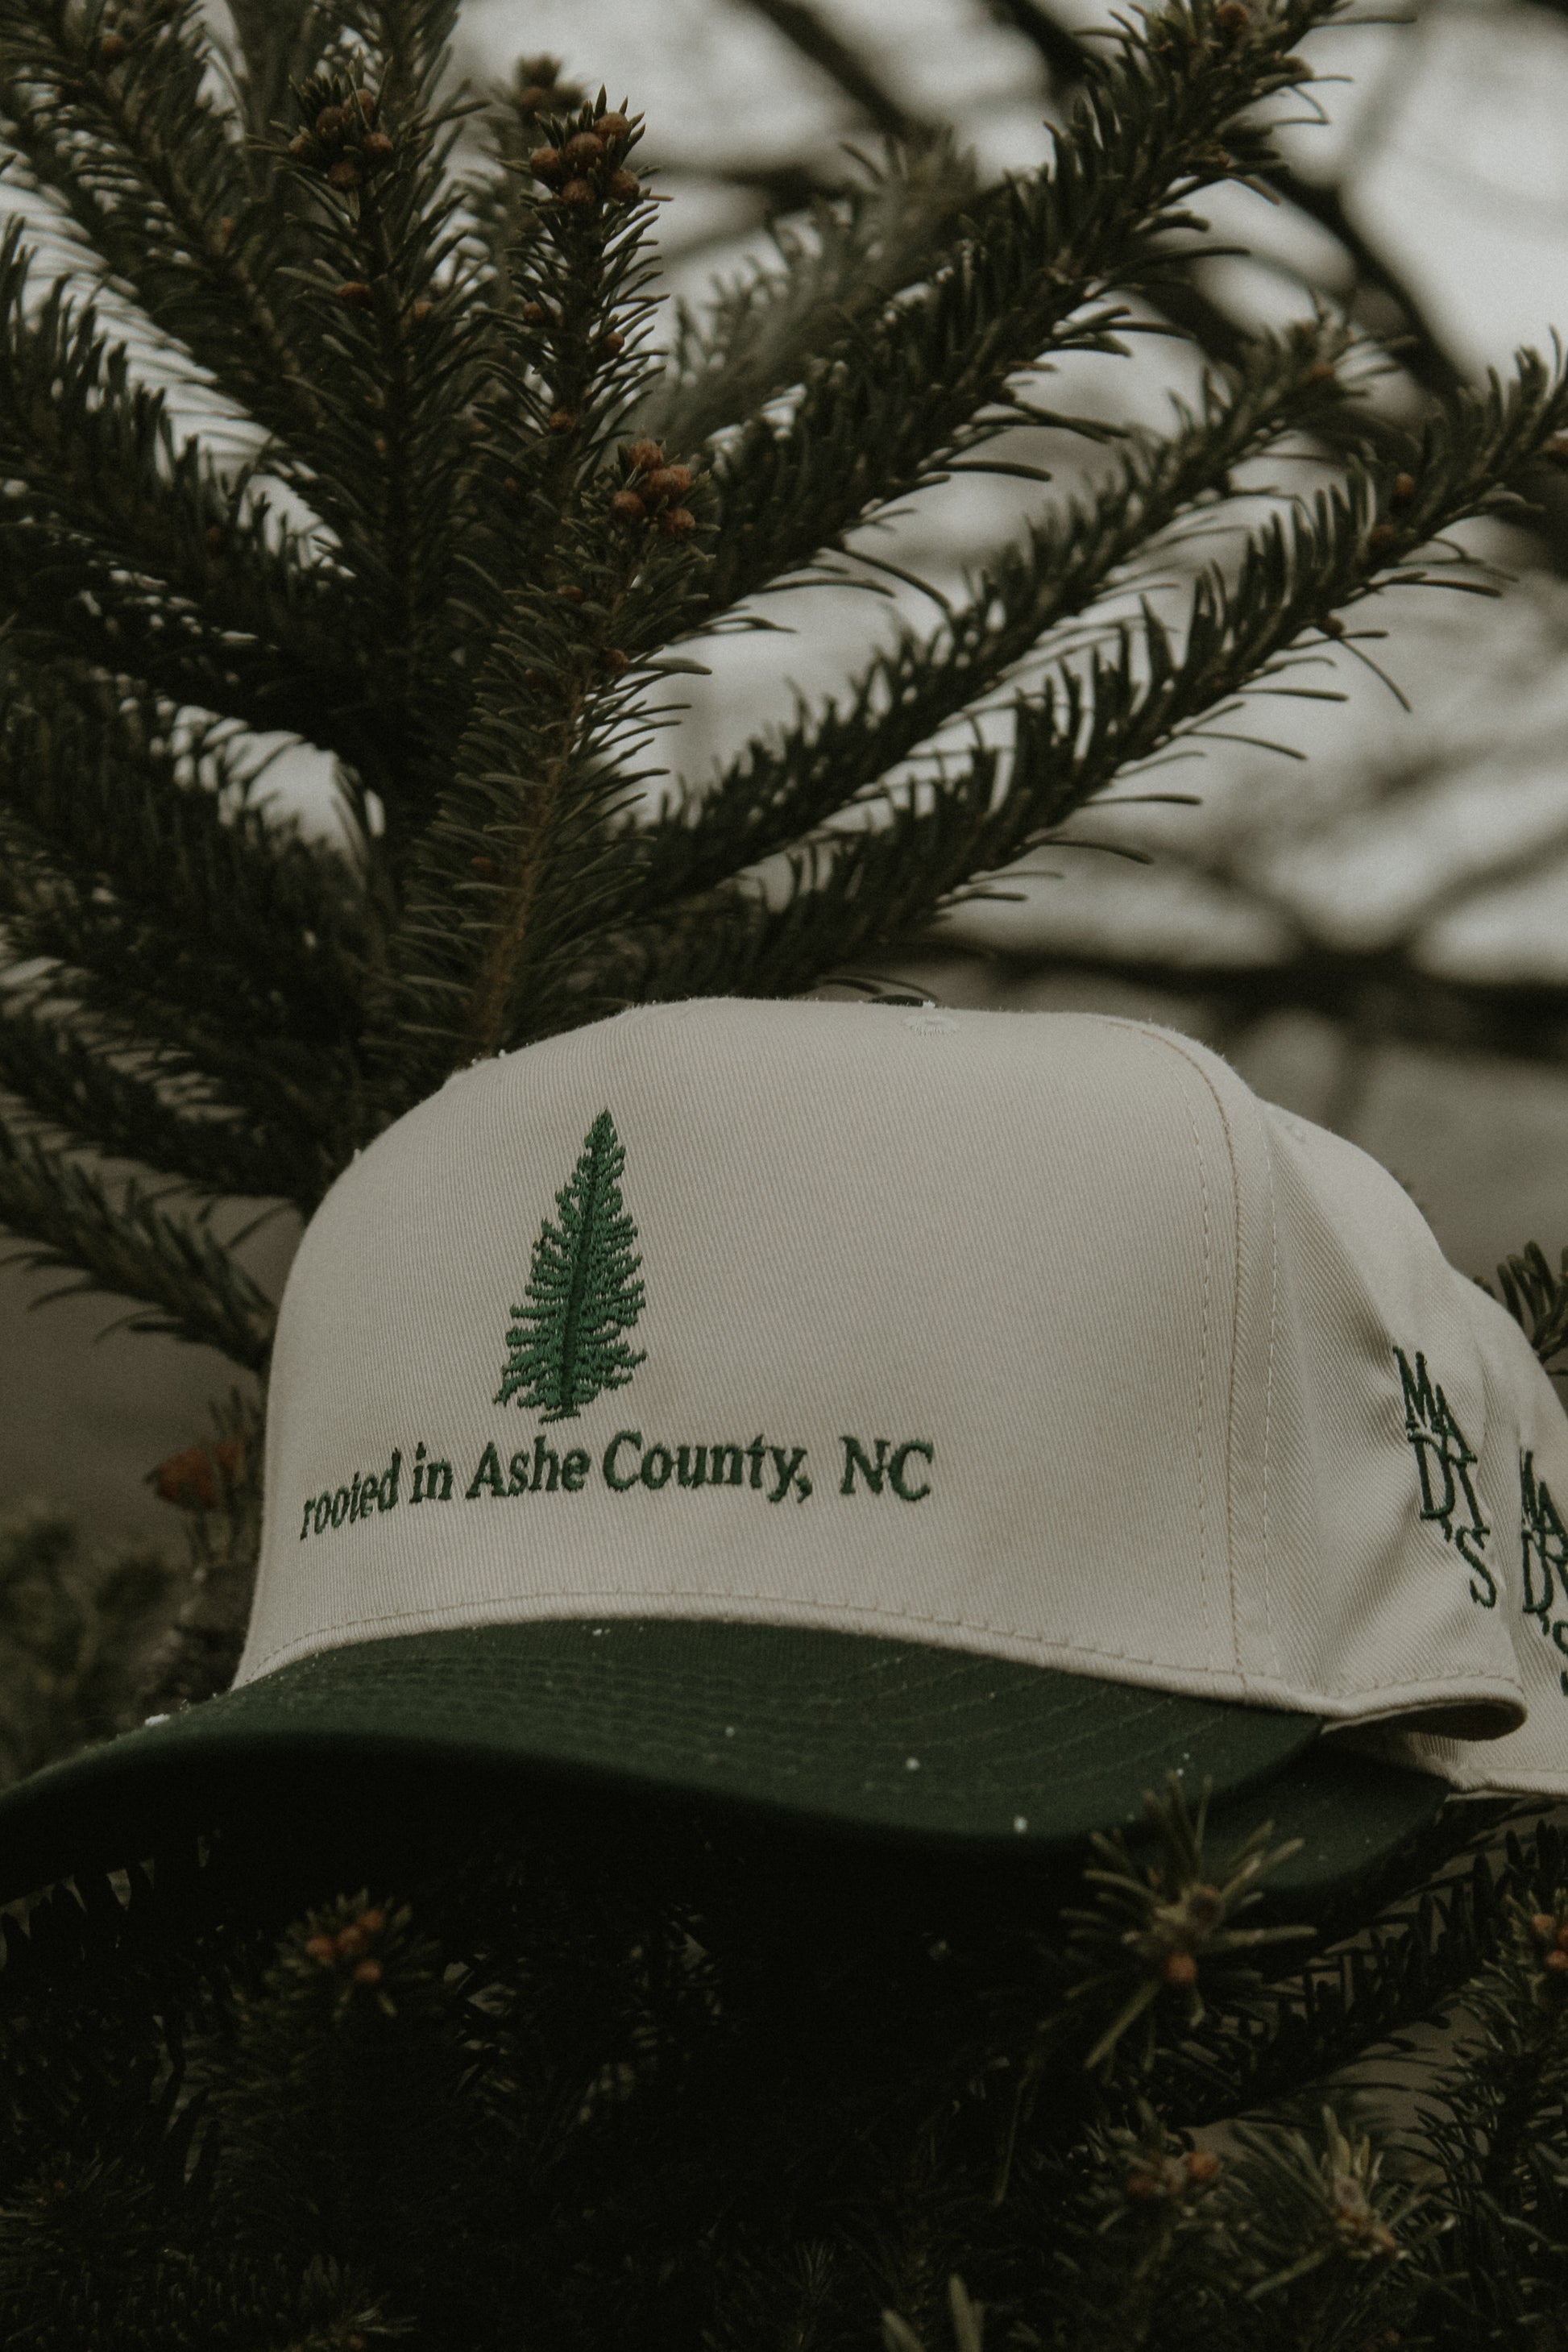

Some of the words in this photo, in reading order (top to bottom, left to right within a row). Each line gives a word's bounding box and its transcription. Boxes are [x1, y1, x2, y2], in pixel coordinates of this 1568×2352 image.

[300, 1447, 402, 1541] rooted
[409, 1441, 453, 1504] in
[465, 1435, 591, 1499] Ashe
[602, 1429, 813, 1504] County,
[839, 1436, 933, 1501] NC
